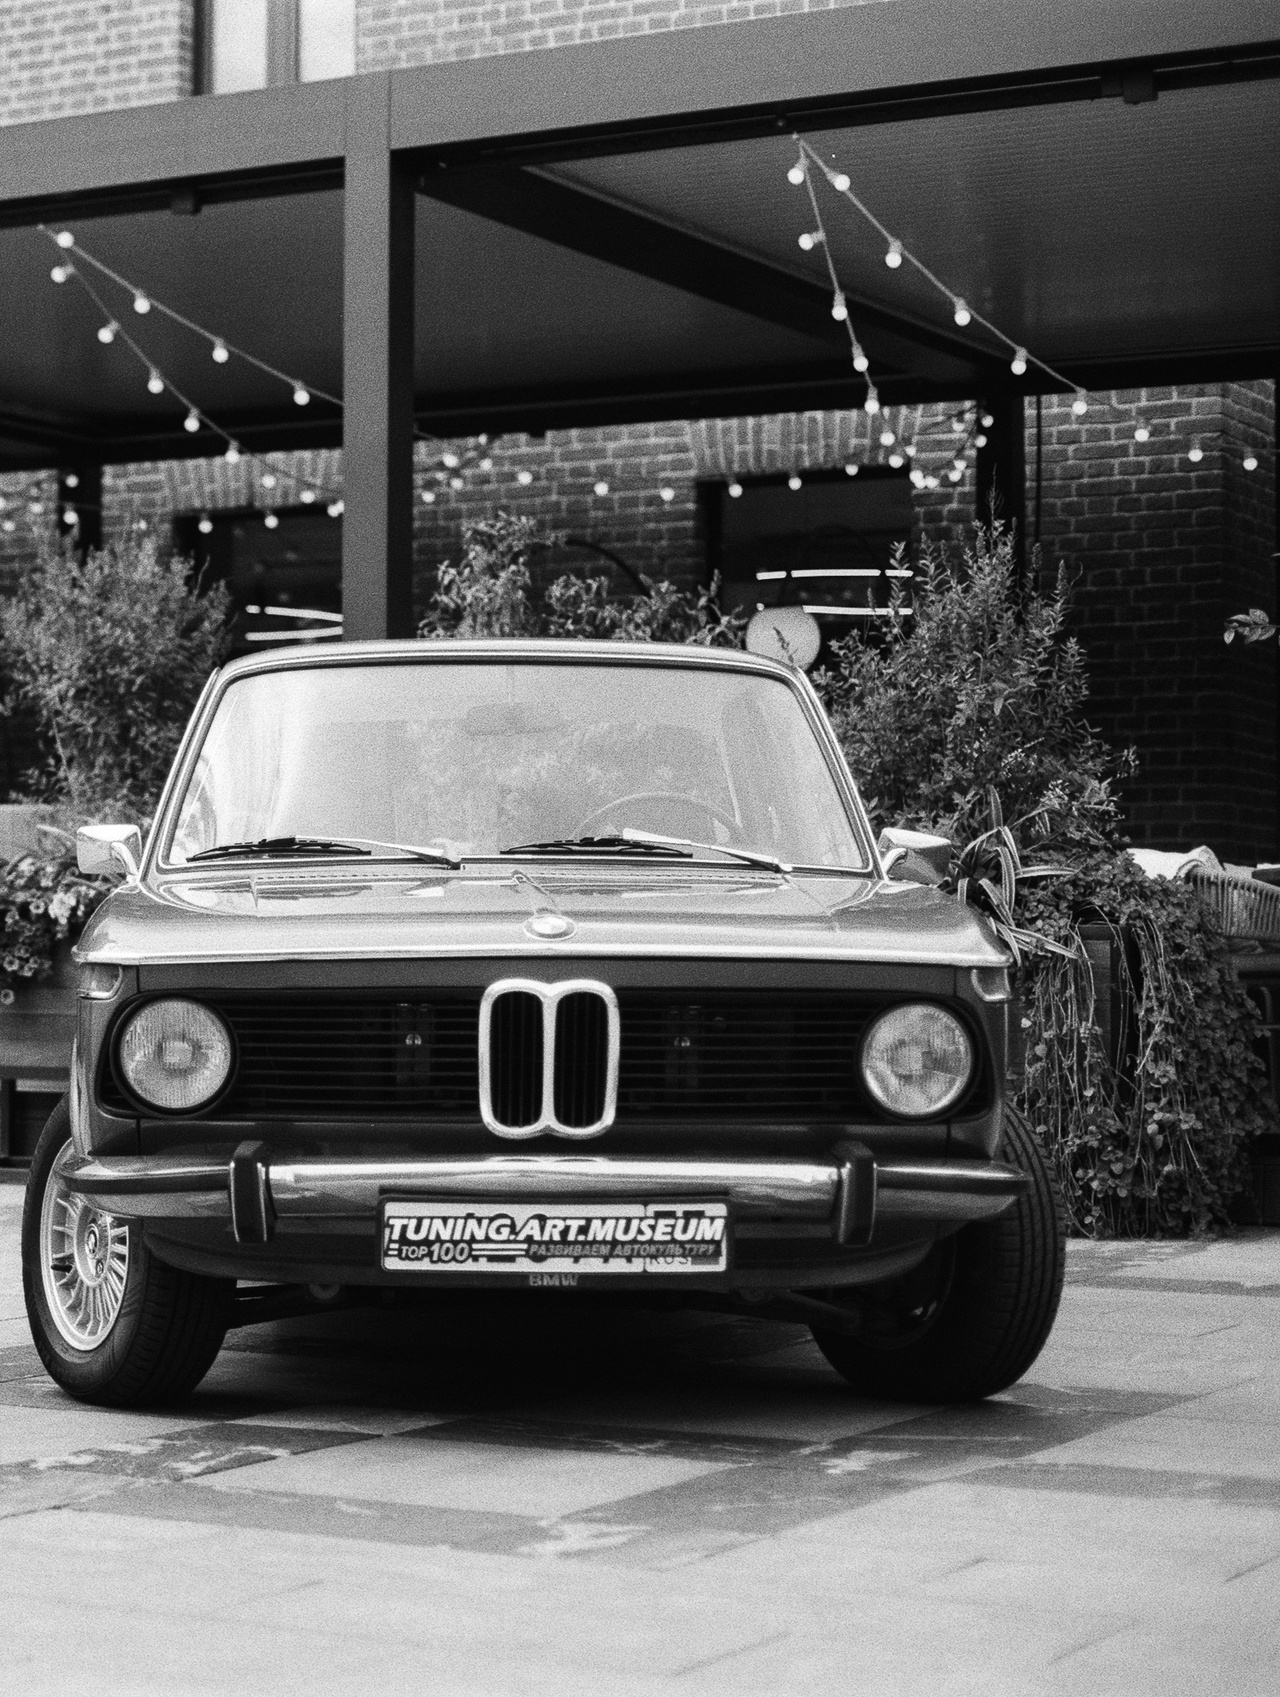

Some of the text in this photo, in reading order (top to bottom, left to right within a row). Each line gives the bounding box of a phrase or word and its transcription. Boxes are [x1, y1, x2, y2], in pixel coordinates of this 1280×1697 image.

[388, 1218, 725, 1242] TUNING.ART.MUSEUM
[400, 1242, 470, 1262] TOP 100
[612, 1243, 715, 1256] АВТОКУЛЬТУРУ
[529, 1273, 579, 1286] BMW
